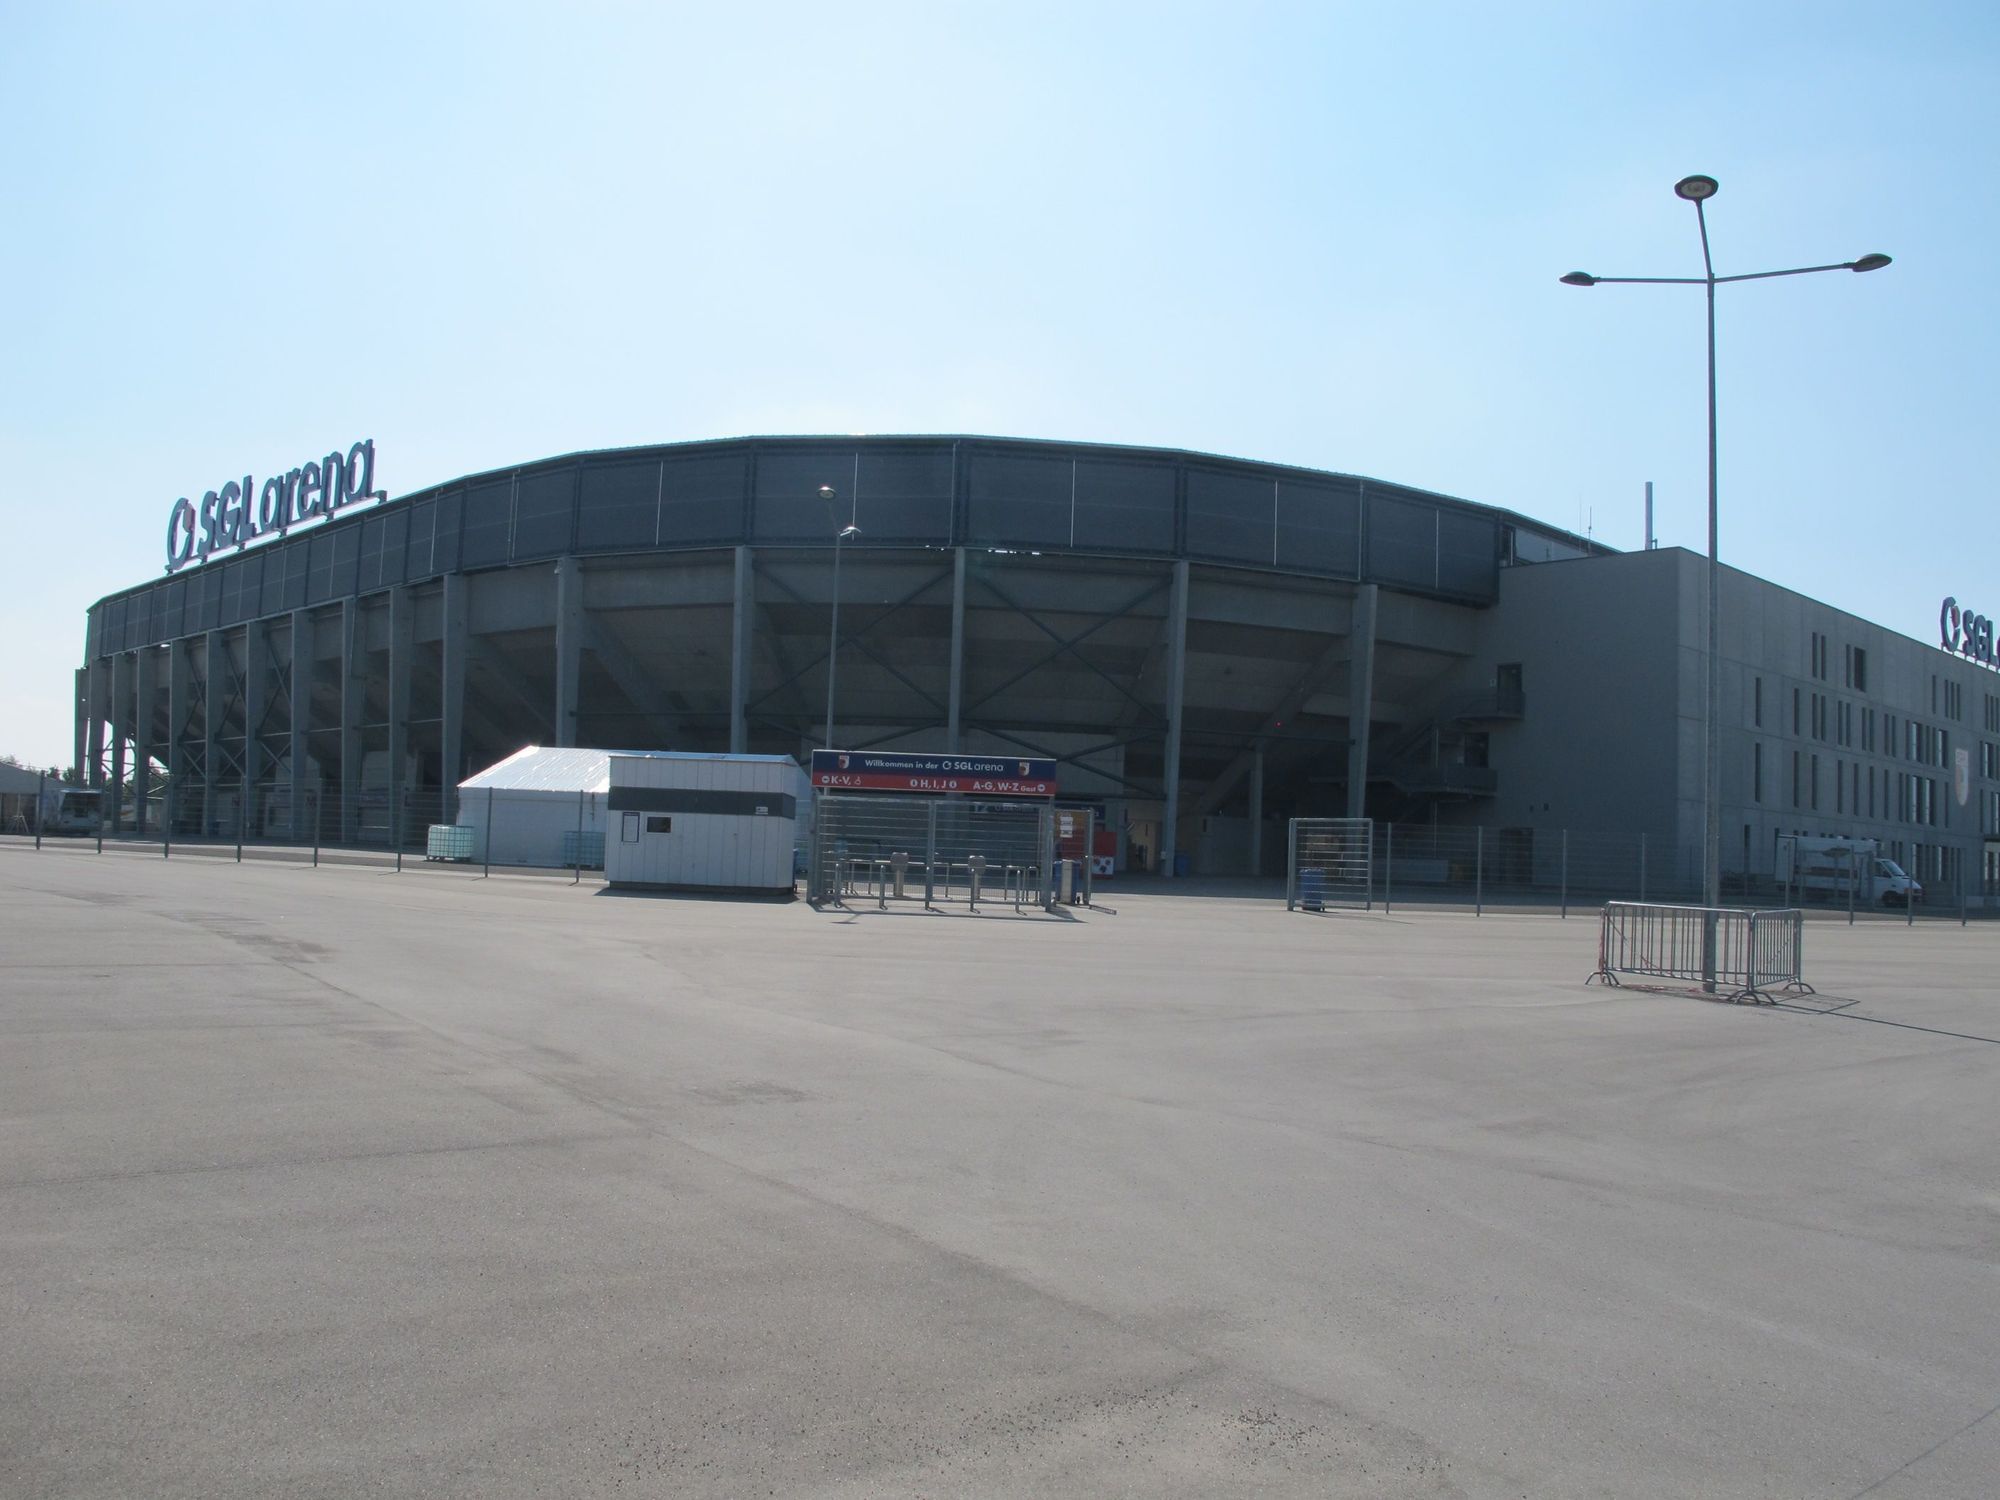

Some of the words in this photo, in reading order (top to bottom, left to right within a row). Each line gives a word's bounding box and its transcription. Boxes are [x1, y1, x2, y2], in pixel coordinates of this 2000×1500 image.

[197, 475, 256, 555] SGL
[259, 439, 375, 533] arena
[1962, 609, 1998, 666] SGL
[865, 760, 914, 768] Willkommen
[954, 762, 972, 770] SGL
